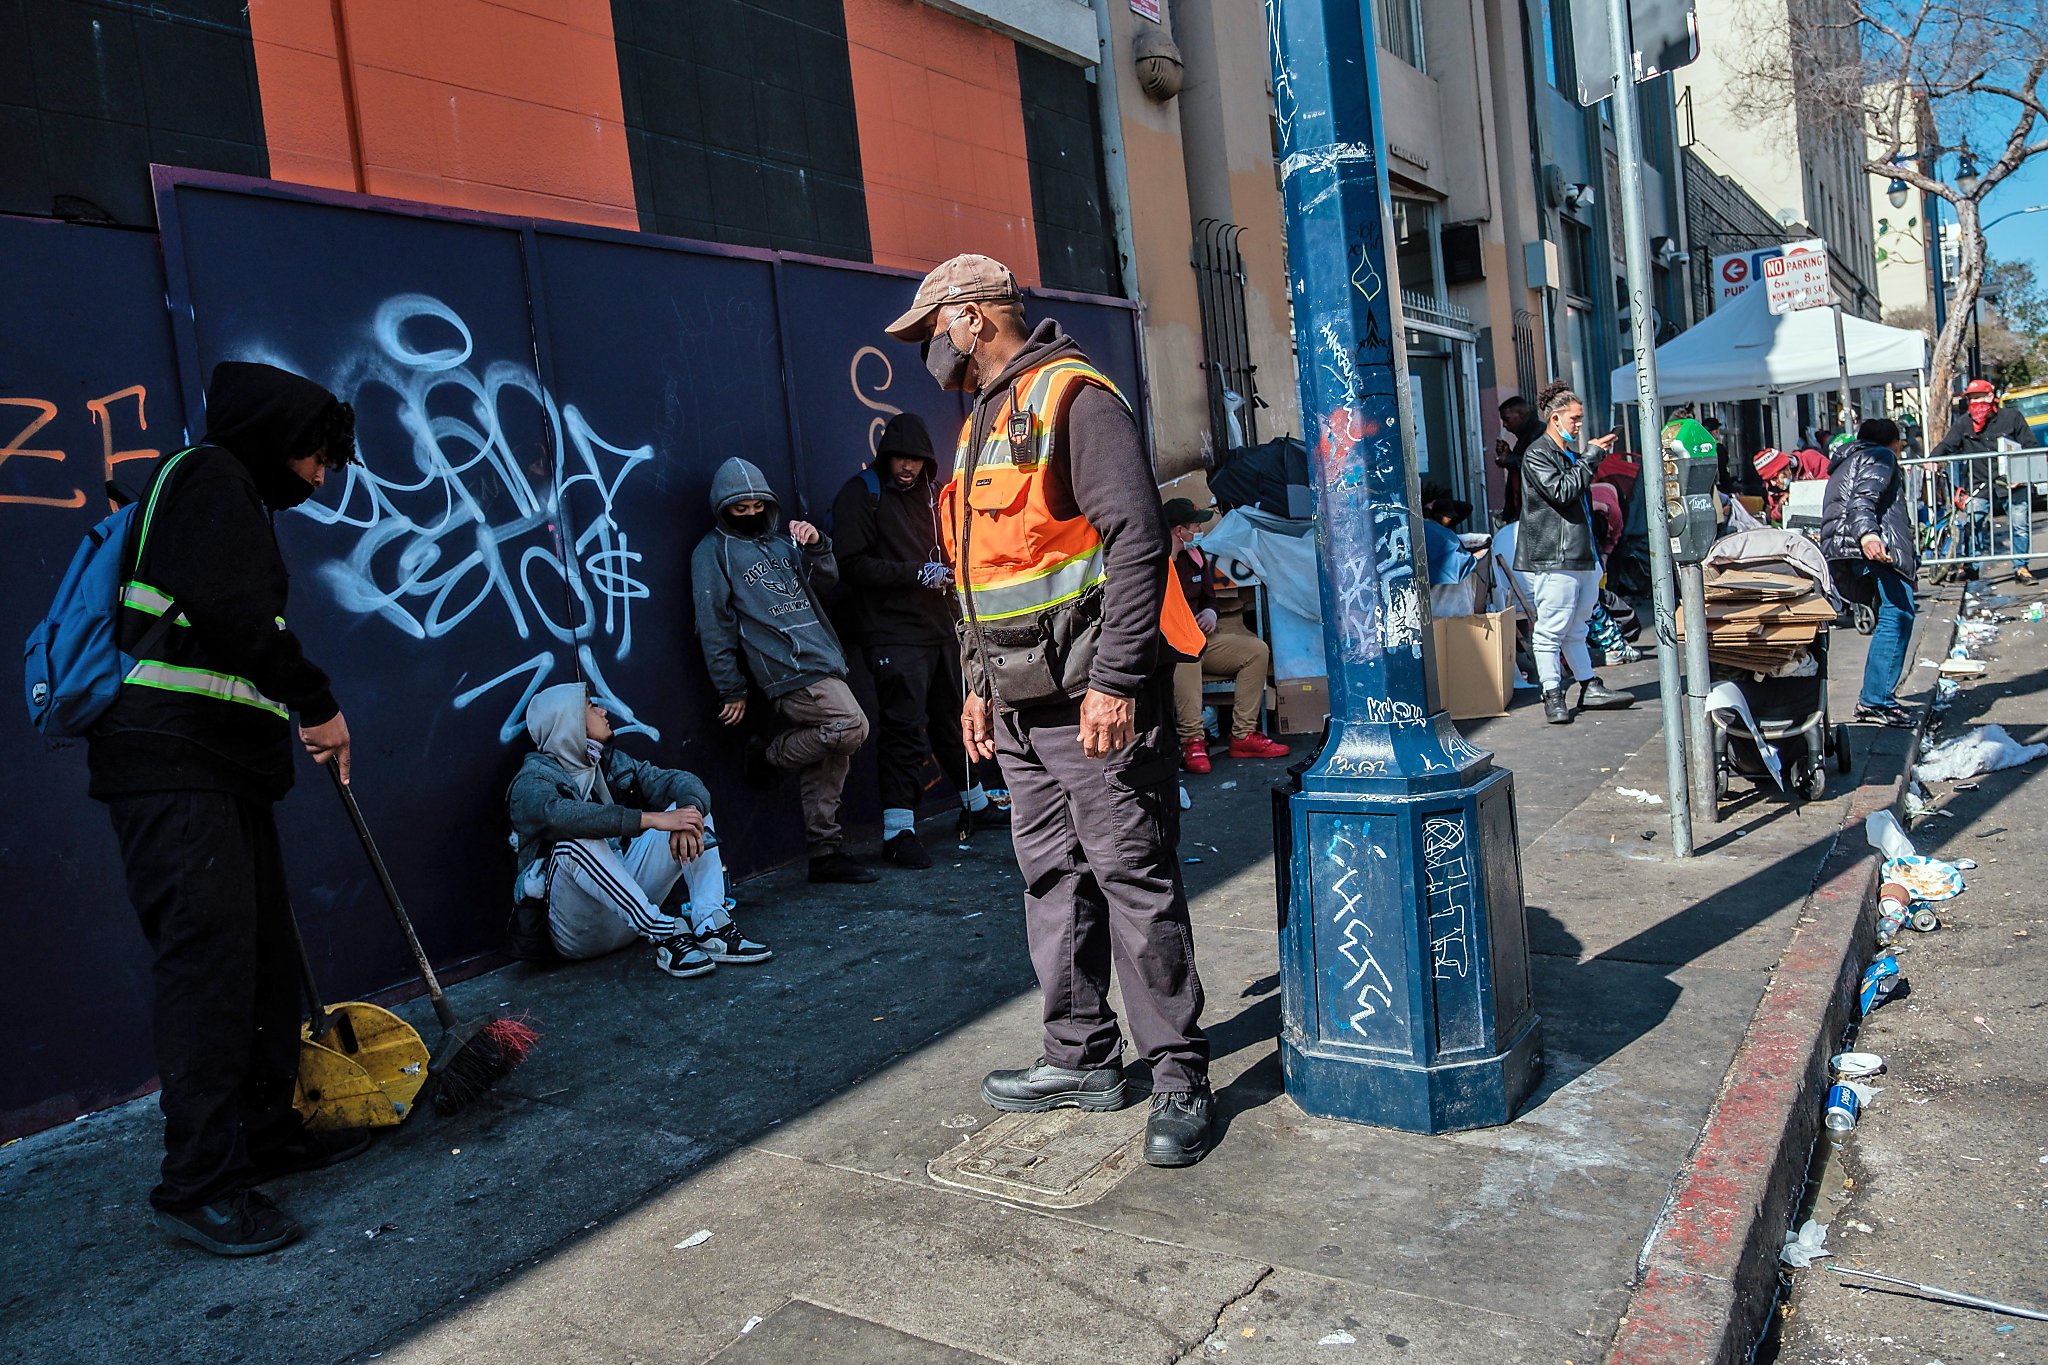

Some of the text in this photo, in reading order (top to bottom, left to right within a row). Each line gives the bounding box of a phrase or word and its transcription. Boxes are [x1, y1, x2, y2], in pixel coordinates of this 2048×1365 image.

[1767, 261, 1783, 276] NO
[1786, 256, 1823, 272] PARKING
[1814, 284, 1825, 295] SAT
[743, 562, 769, 587] 2012
[769, 605, 783, 616] THE
